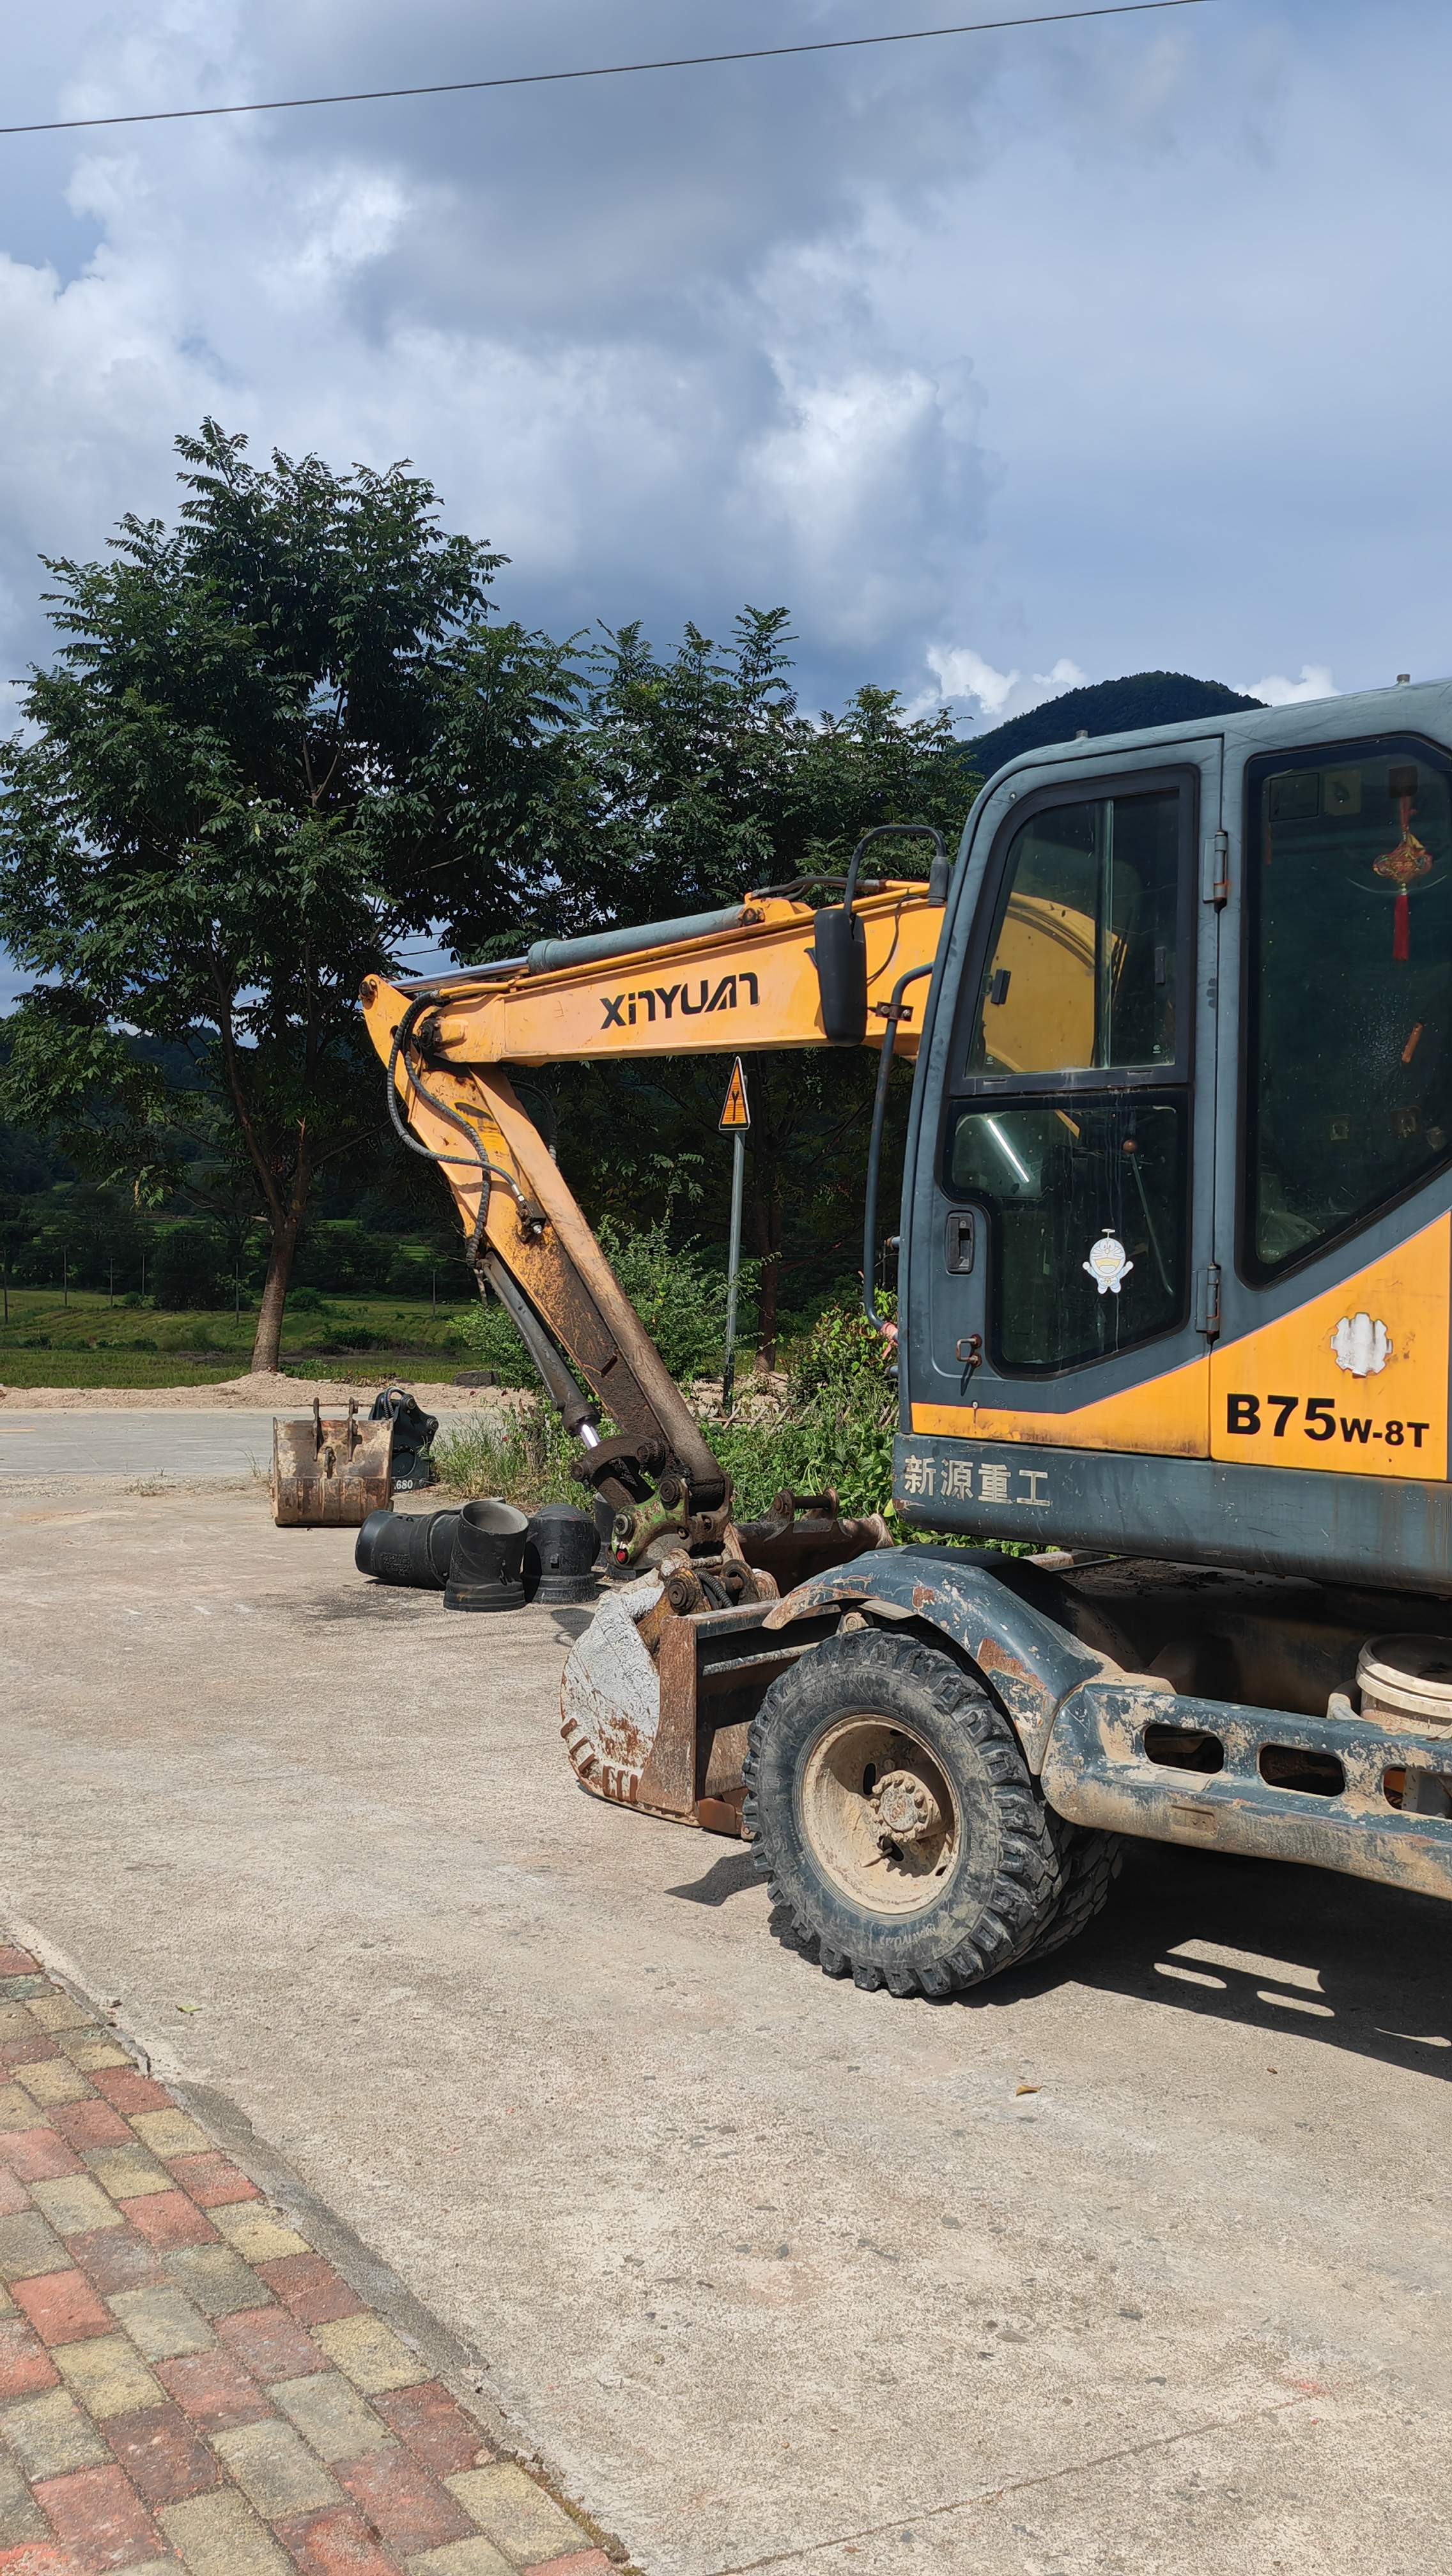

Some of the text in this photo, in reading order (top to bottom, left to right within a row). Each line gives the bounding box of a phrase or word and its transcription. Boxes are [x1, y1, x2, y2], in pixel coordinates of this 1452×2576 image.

[1226, 1393, 1430, 1448] B75W-8T
[394, 1479, 413, 1489] 680
[904, 1454, 1051, 1506] 新源重工
